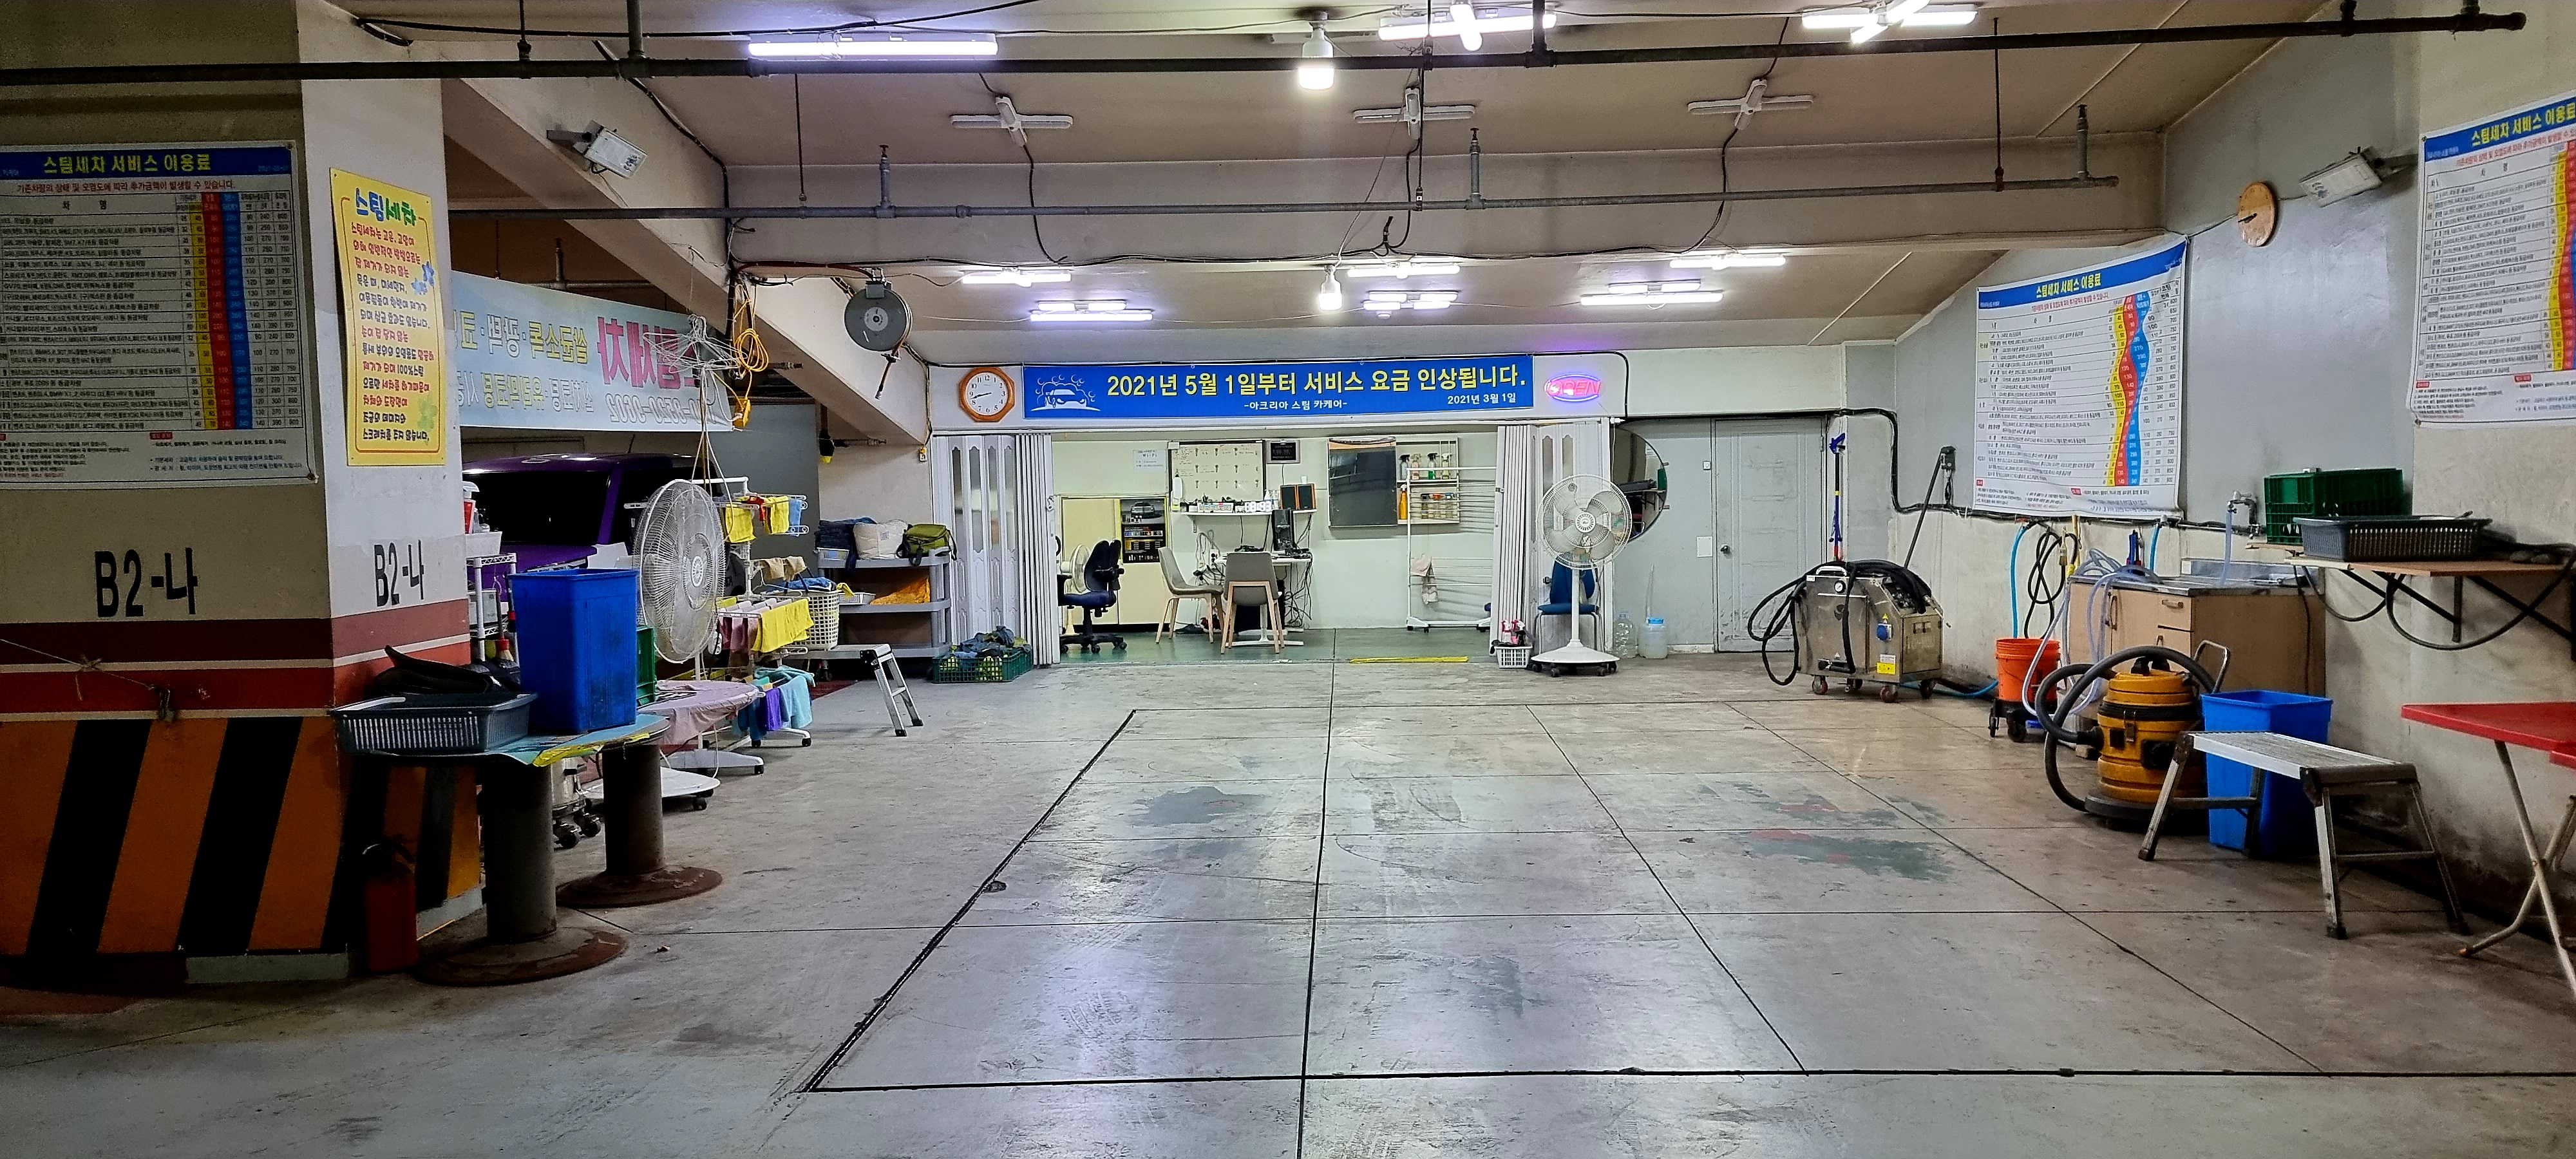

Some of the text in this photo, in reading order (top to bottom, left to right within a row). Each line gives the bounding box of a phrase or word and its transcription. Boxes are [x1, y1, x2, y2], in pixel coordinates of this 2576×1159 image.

[2472, 122, 2510, 147] 스팀세차
[2512, 113, 2542, 135] 서비스
[44, 154, 211, 174] 스팀세차 서비스 이용료
[355, 187, 417, 226] 스팀세차
[2036, 272, 2101, 299] 스팀세차 서비스 이용료
[1108, 364, 1526, 397] 2021년 5월 1일부터 서비스 요금 인상됩니다.
[1547, 379, 1600, 396] OPEN
[1244, 399, 1348, 411] -아크리아 스팀 카케어-
[1448, 392, 1517, 405] 2021년 3월 1일
[95, 547, 198, 617] B2-나
[374, 540, 424, 608] B2-나
